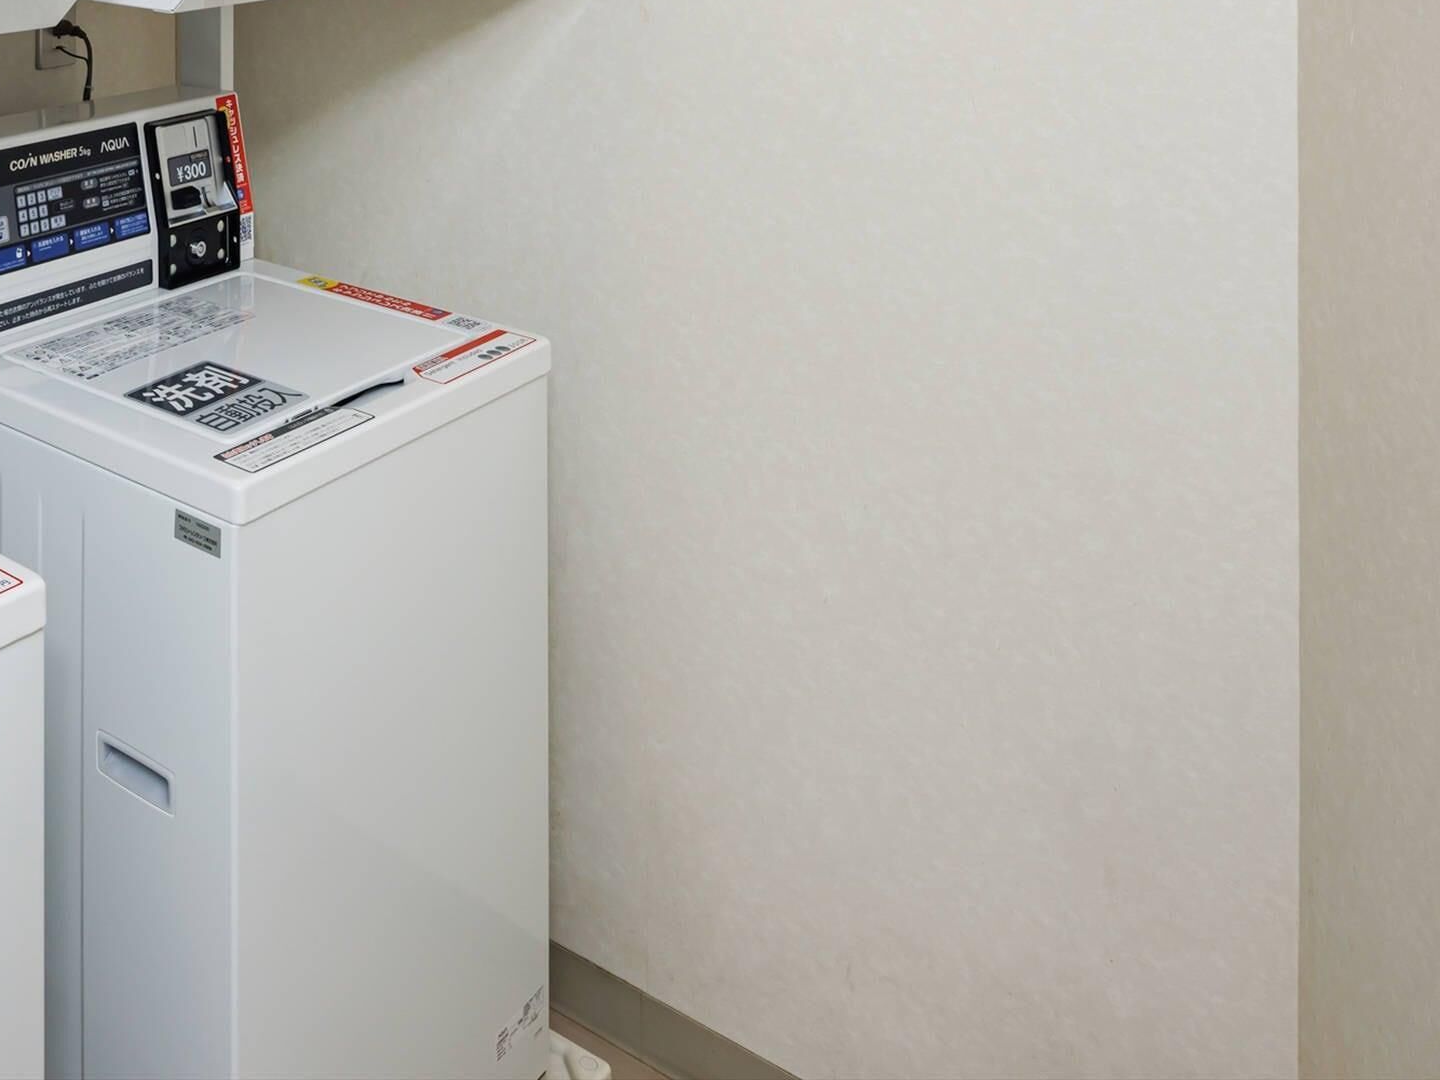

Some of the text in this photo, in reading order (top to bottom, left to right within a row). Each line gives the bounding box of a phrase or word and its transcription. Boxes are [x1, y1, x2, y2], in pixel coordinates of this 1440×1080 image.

[100, 136, 129, 153] AQUA
[40, 147, 77, 166] WASHER
[177, 161, 206, 182] ¥300
[142, 366, 250, 412] 洗剤
[196, 388, 302, 431] 自動投入
